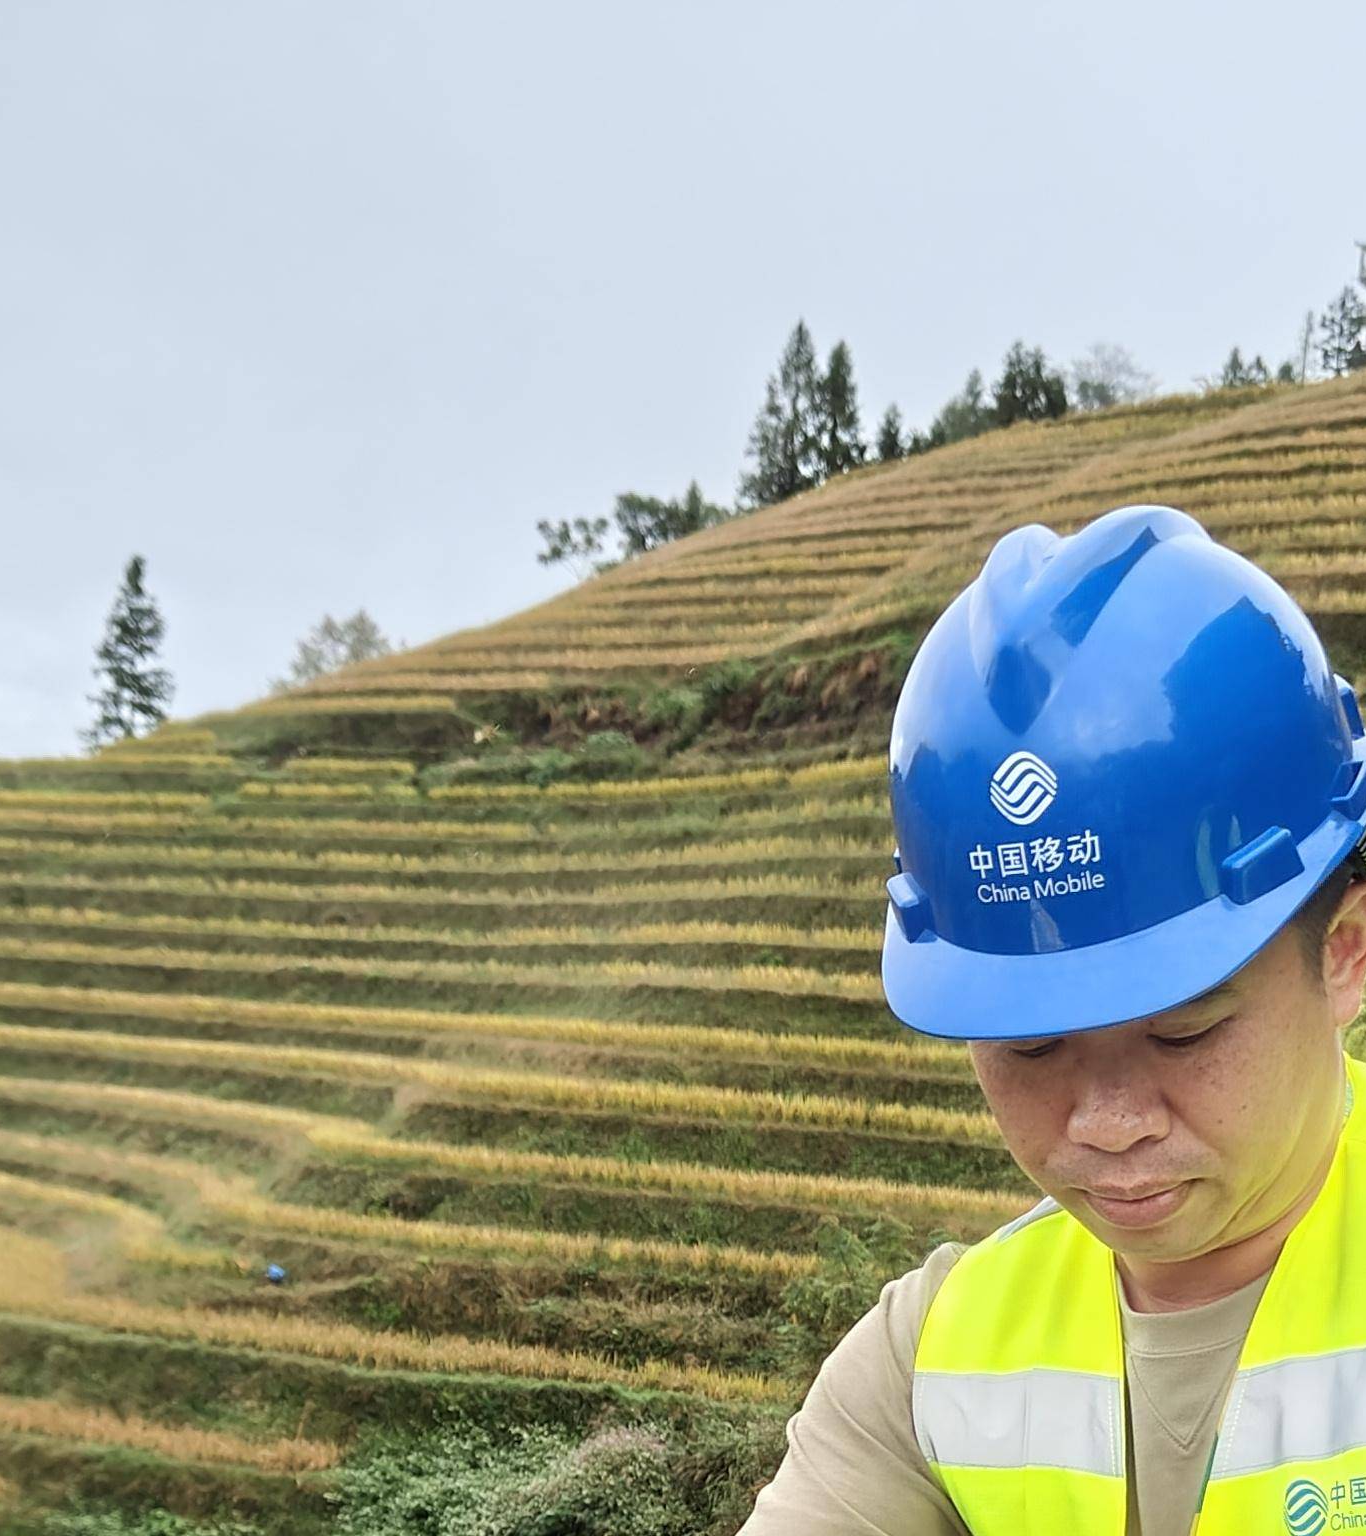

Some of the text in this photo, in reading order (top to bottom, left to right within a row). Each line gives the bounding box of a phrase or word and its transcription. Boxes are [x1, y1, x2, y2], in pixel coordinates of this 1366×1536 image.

[969, 829, 1101, 879] 中国移动
[977, 870, 1105, 903] China Mobile
